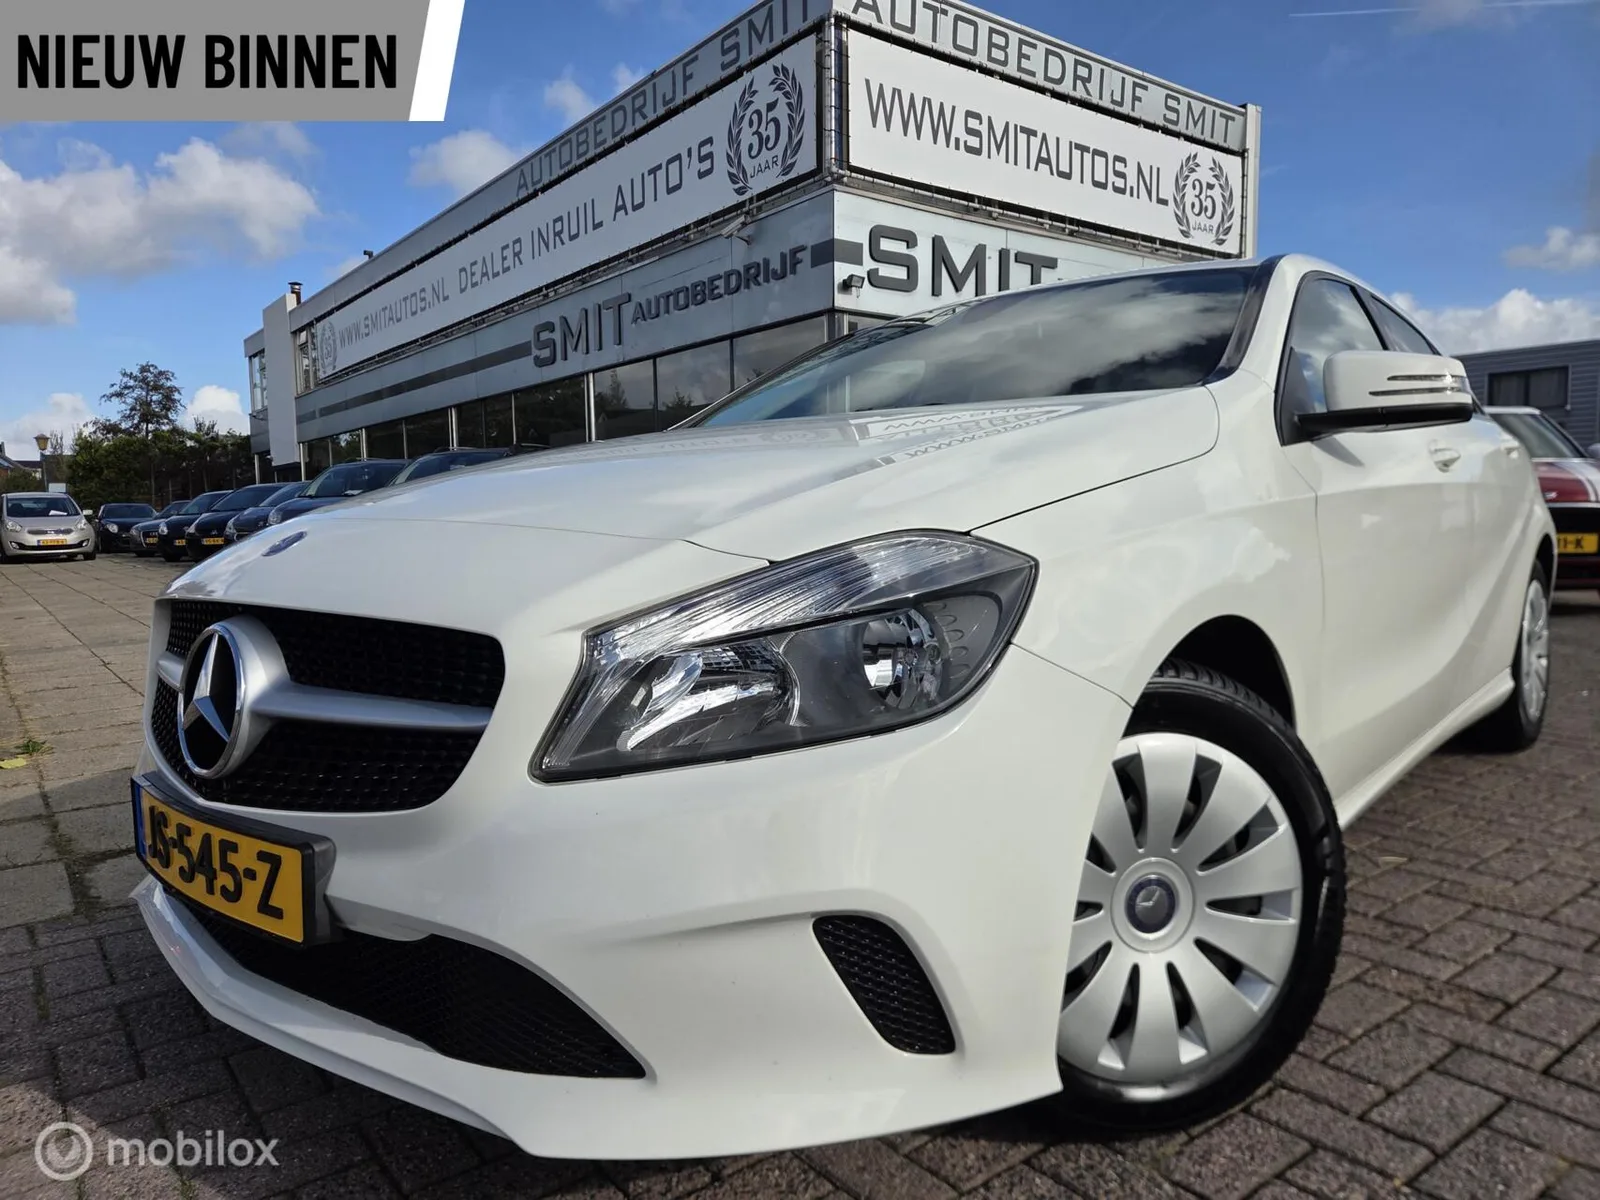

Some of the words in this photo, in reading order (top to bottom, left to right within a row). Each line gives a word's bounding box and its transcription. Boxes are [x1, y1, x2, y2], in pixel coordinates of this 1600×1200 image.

[516, 54, 699, 197] AUTOBEDRIJF
[747, 98, 781, 159] 35
[864, 78, 1169, 206] WWW.SMITAUTOS.NL
[1163, 93, 1236, 144] SMIT
[750, 154, 779, 179] JAAR
[1190, 178, 1216, 220] 35
[338, 277, 449, 349] WWW.SMITAUTOS.NL
[458, 237, 523, 293] DEALER
[531, 198, 603, 260] INRUIL
[613, 136, 714, 221] AUTO'S
[867, 223, 1058, 297] SMIT
[1192, 221, 1214, 235] JAAR
[532, 291, 631, 368] SMIT
[631, 244, 808, 325] AUTOBEDRIJF
[148, 805, 284, 920] JS-545-Z
